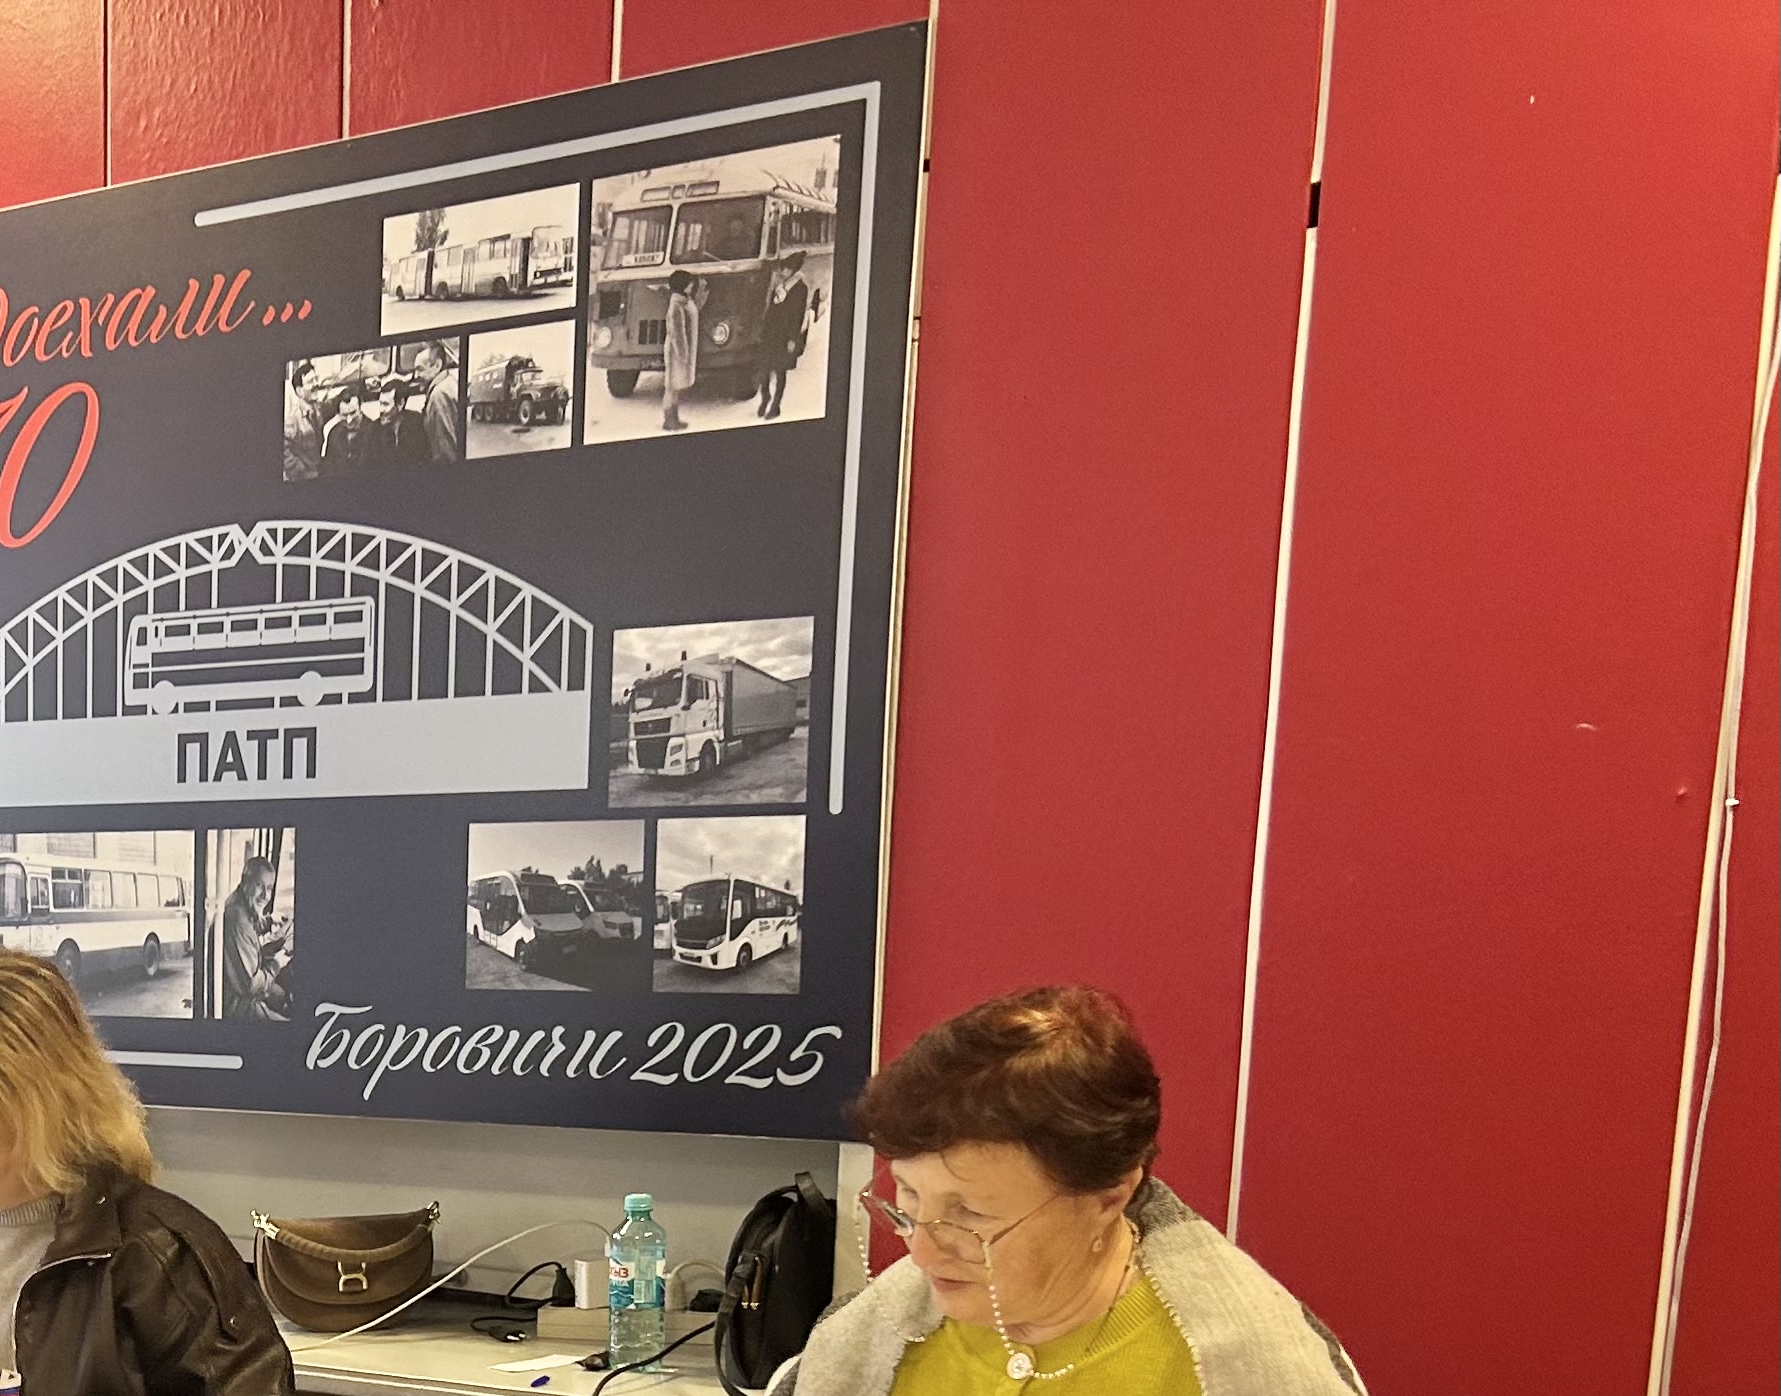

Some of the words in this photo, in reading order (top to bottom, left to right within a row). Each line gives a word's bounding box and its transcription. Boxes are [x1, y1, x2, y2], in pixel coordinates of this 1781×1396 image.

[177, 727, 317, 783] ПАТП
[304, 1002, 627, 1100] Боровичи
[630, 1021, 842, 1088] 2025
